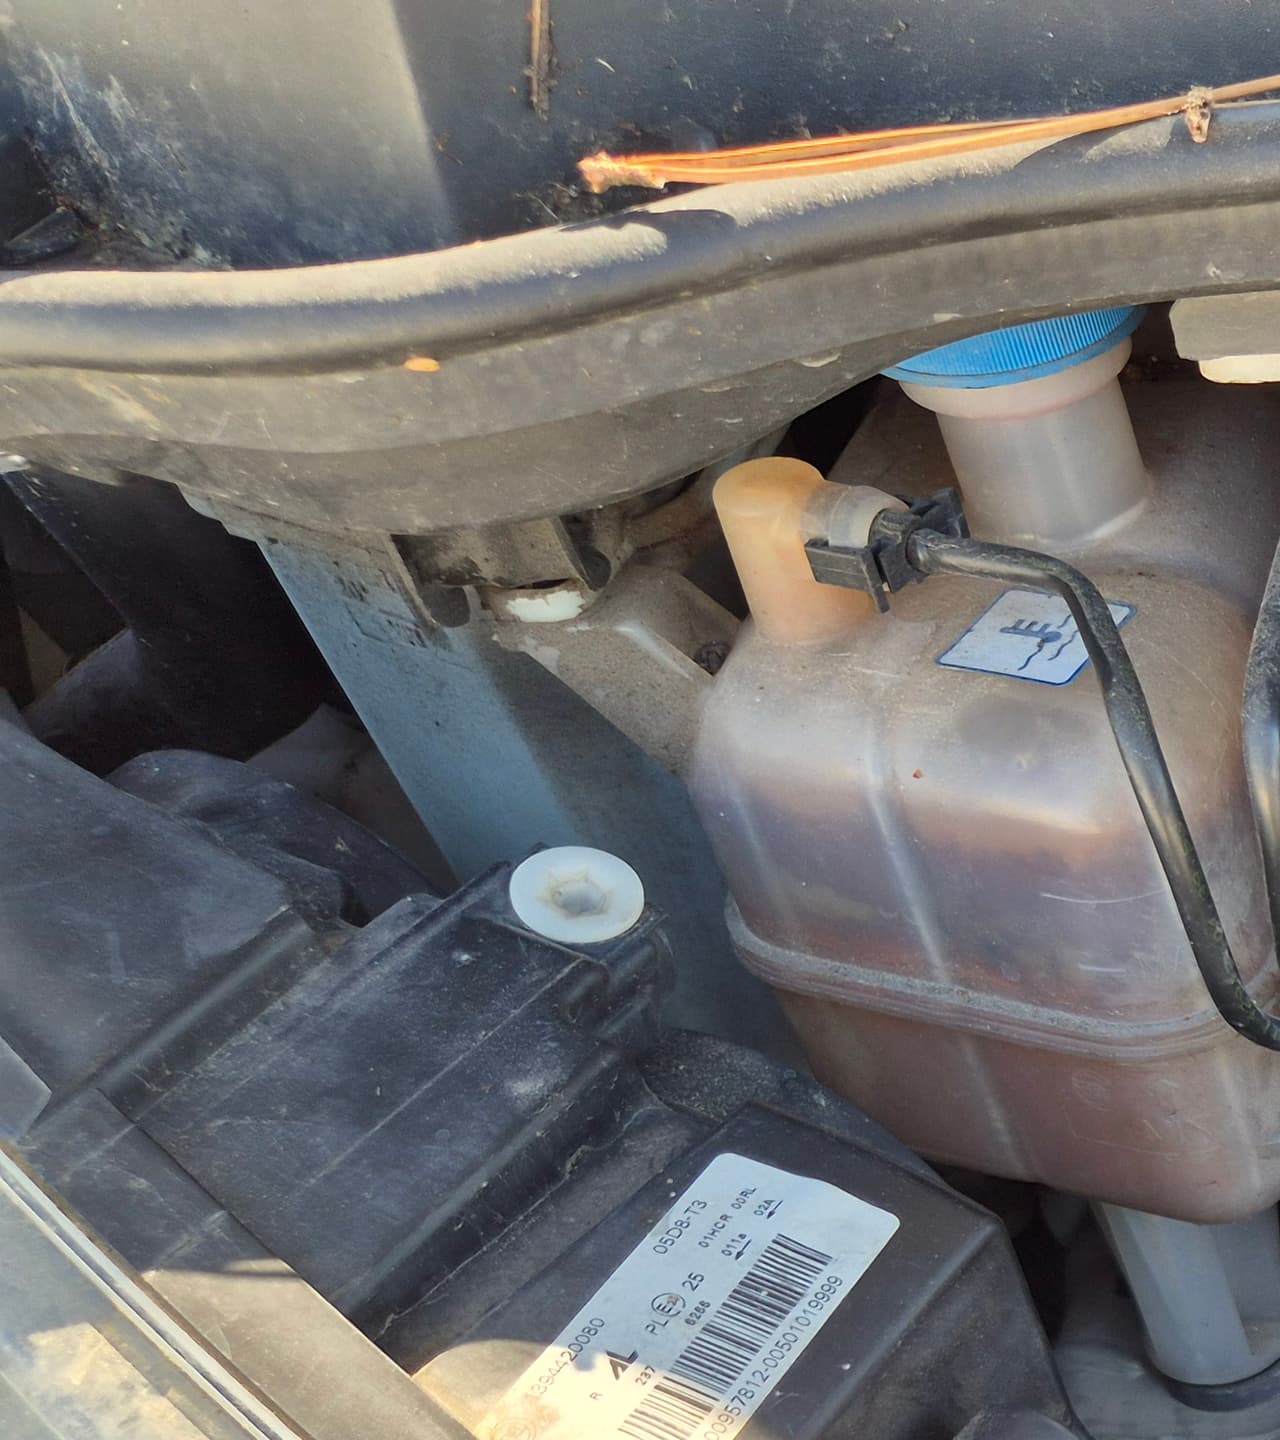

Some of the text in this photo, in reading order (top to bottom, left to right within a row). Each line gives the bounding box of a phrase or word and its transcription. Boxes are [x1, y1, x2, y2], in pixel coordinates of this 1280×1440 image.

[651, 1196, 709, 1256] 05D8-T3
[696, 1184, 757, 1249] 01HCR 00RL
[752, 1196, 775, 1217] 02A
[588, 1390, 603, 1401] R
[643, 1314, 669, 1336] PL
[680, 1270, 706, 1292] 25
[633, 1364, 657, 1386] 237
